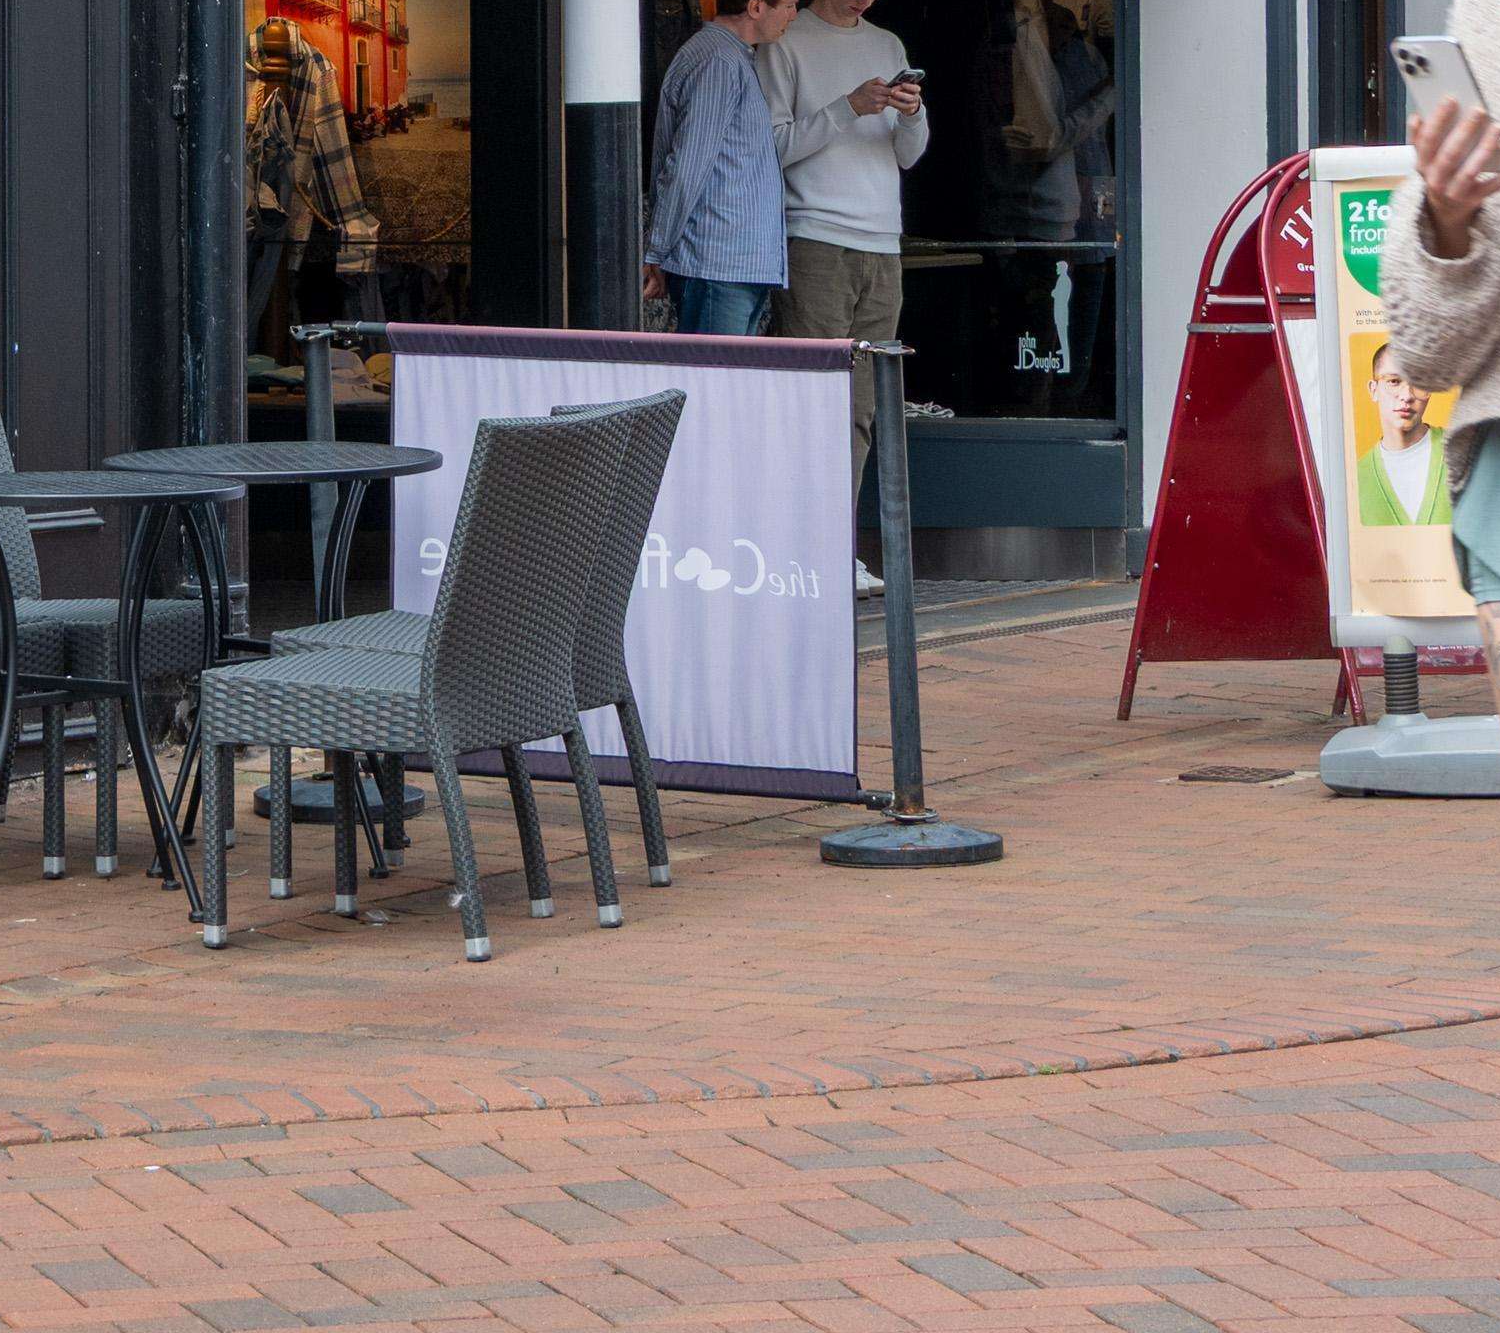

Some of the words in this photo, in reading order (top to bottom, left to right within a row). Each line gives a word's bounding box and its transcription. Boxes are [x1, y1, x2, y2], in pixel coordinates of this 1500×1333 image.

[1348, 201, 1365, 222] 2
[1365, 199, 1392, 221] fo
[1350, 245, 1385, 255] includi
[1022, 348, 1060, 373] Douglas
